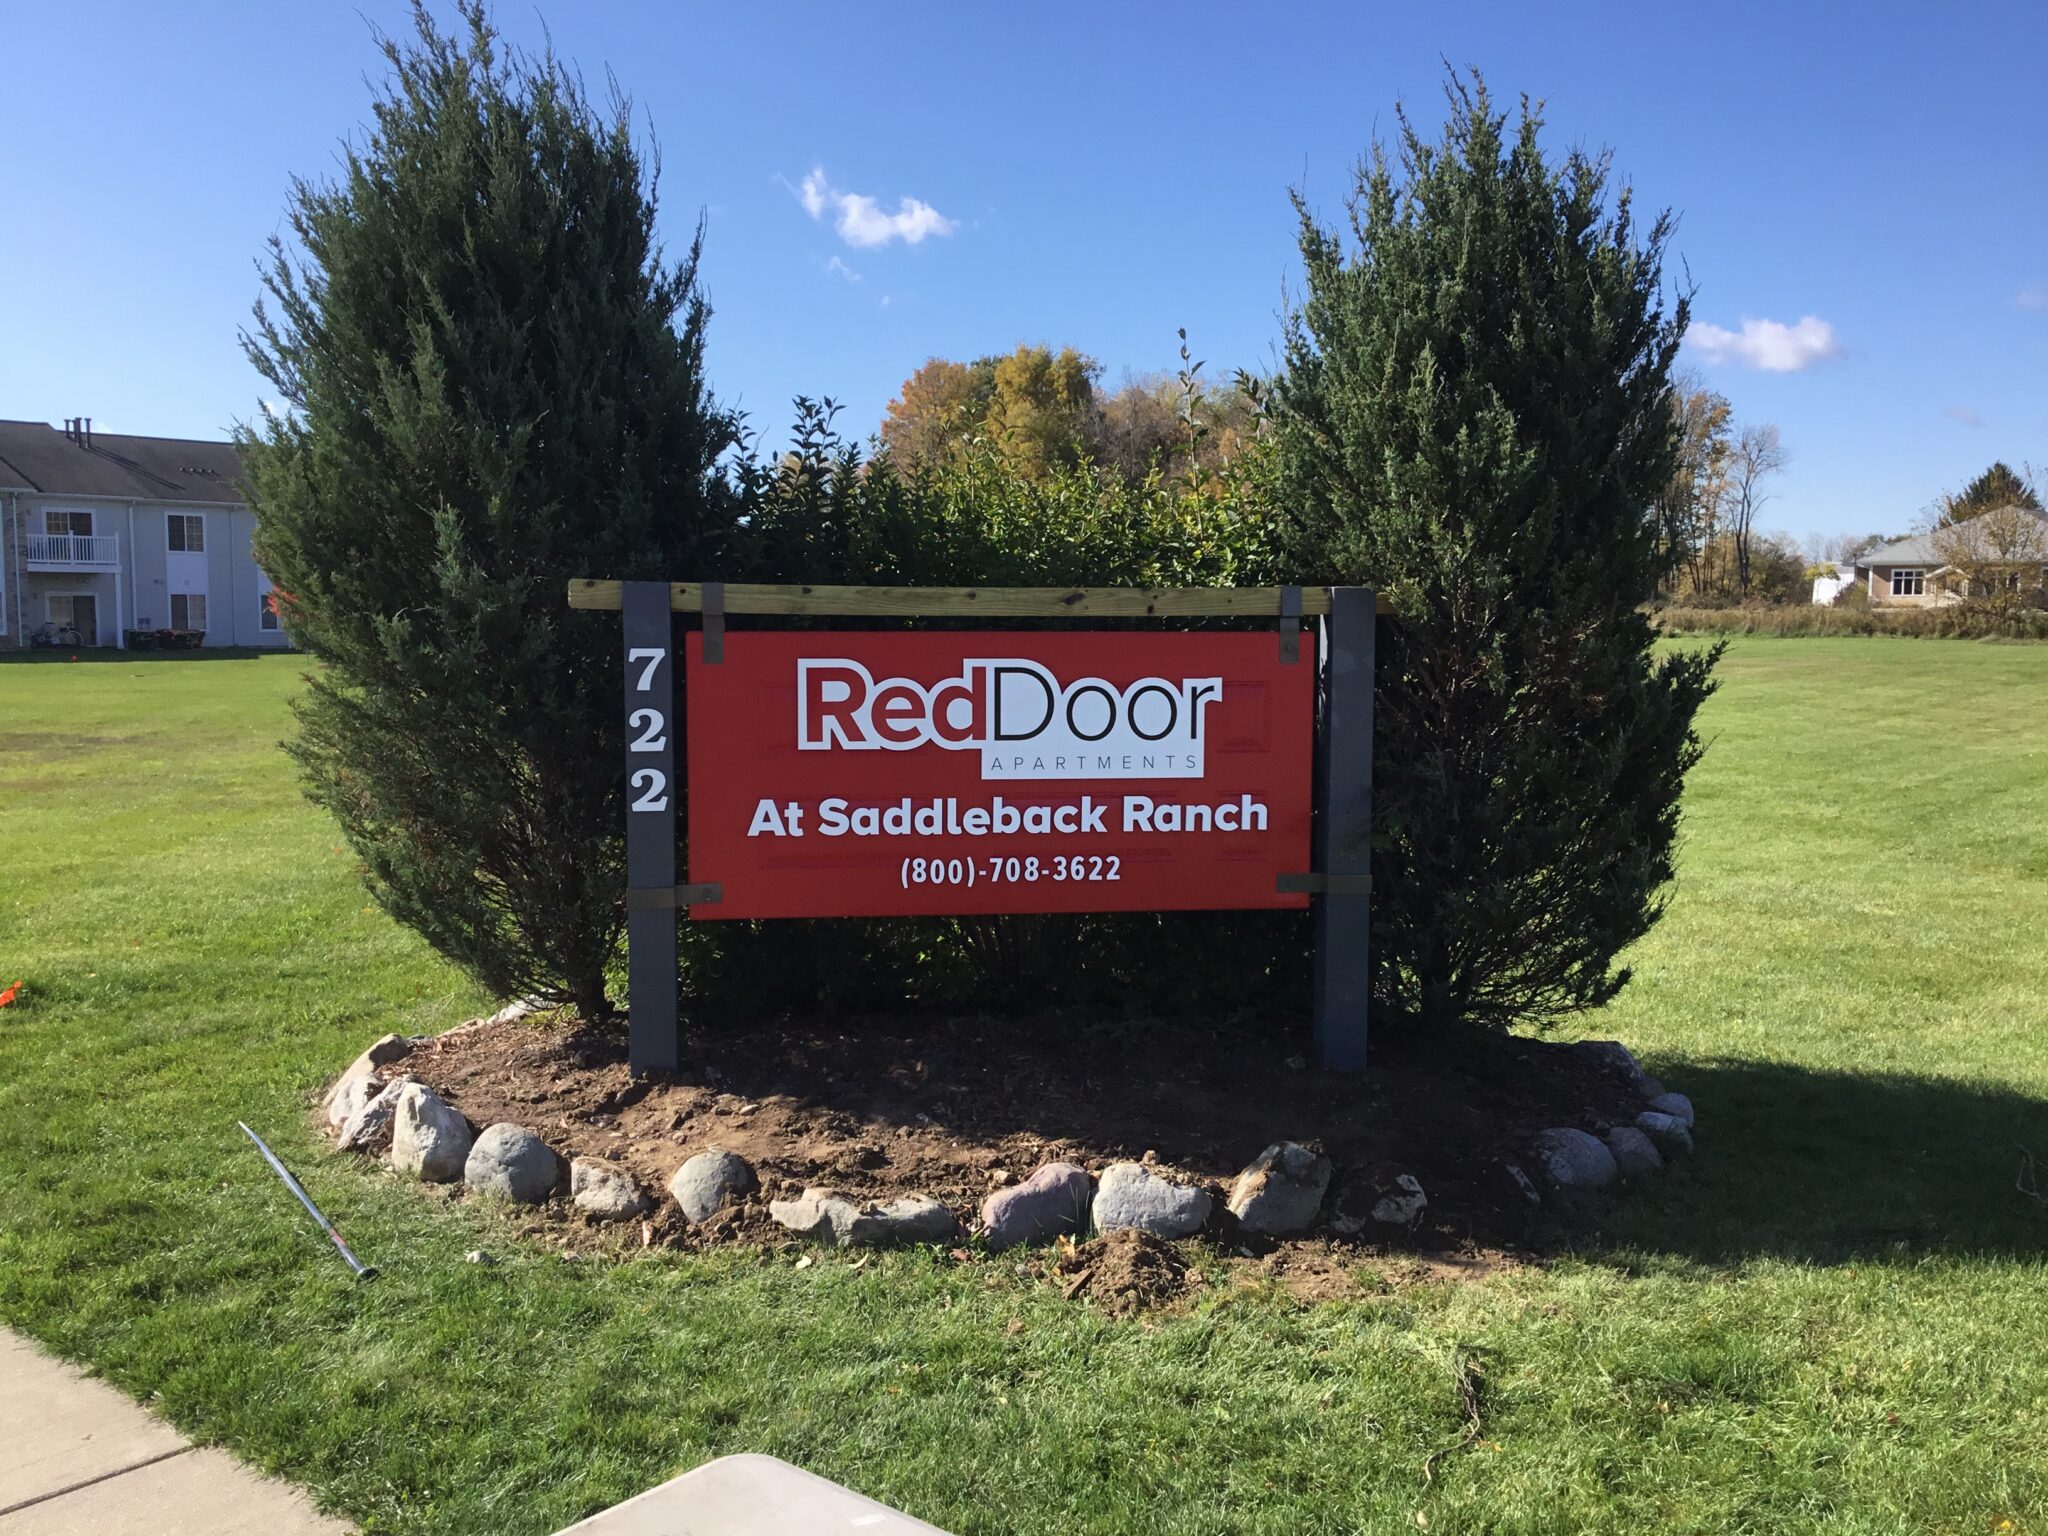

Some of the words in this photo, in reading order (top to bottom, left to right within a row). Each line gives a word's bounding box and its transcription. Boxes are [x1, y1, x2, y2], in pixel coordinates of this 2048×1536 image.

[990, 754, 1197, 771] APARTMENTS
[747, 799, 804, 837] At
[818, 796, 1108, 836] Saddleback
[1123, 794, 1268, 833] Ranch
[901, 855, 1121, 889] (800)-708-3622
